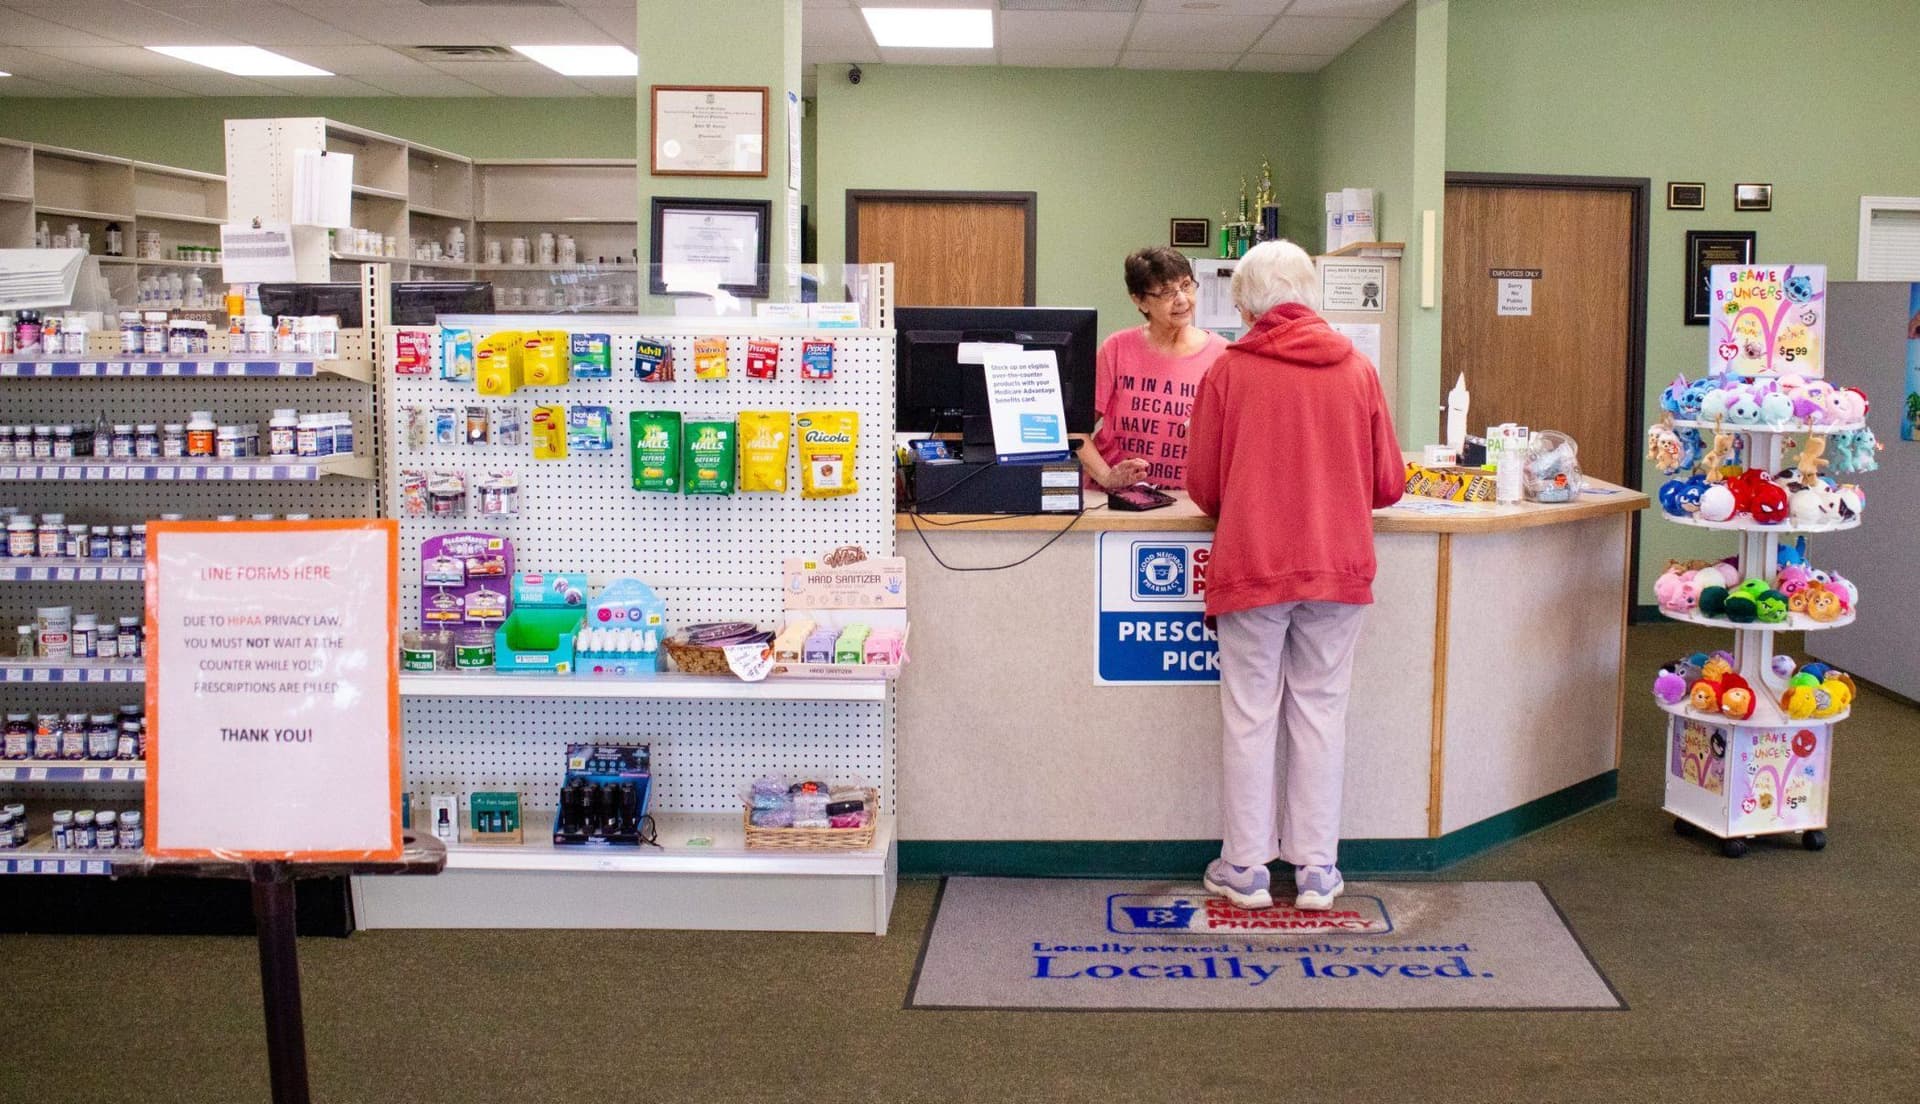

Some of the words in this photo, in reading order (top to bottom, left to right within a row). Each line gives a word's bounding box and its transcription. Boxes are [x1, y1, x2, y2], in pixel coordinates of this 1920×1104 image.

[1730, 269, 1777, 282] BEANIE
[1716, 286, 1782, 300] BOUNCERS
[638, 345, 661, 357] Advil
[1115, 376, 1134, 390] I'M
[1141, 378, 1156, 392] IN
[1163, 381, 1173, 395] A
[1180, 383, 1197, 398] HU
[1131, 397, 1192, 417] BECAUS
[1113, 416, 1117, 431] I
[1121, 417, 1159, 434] HAVE
[1167, 422, 1186, 438] TO
[805, 430, 850, 443] Ricola
[637, 439, 669, 449] HALLS
[691, 441, 725, 451] HALLS
[1161, 443, 1188, 459] BEF
[1145, 463, 1187, 480] ORGE
[1140, 554, 1155, 573] GOOD
[1156, 552, 1184, 574] NEIGHBOR
[201, 567, 232, 580] LINE
[237, 567, 290, 580] FORMS
[294, 566, 331, 580] HERE
[808, 576, 832, 584] HAND
[835, 575, 881, 584] SANITIZER
[1142, 579, 1181, 592] PHARMACY
[184, 616, 206, 627] DUE
[210, 616, 225, 627] TO
[227, 616, 262, 627] HIPAA
[265, 615, 310, 627] PRIVACY
[184, 638, 207, 648] YOU
[211, 638, 243, 648] MUST
[246, 638, 270, 648] NOT
[273, 638, 301, 648] WAIT
[304, 638, 320, 648] AT
[322, 638, 343, 648] THE
[199, 660, 251, 671] COUNTER
[255, 660, 289, 671] WHILE
[292, 660, 323, 671] YOUR
[279, 682, 300, 693] ARE
[220, 729, 269, 742] THANK
[274, 729, 313, 742] YOU!
[1752, 733, 1787, 745] BEANE
[1207, 910, 1360, 919] NEIGHBOR
[1207, 920, 1373, 929] PHARMACY
[1033, 943, 1136, 954] Locally
[1142, 944, 1239, 952] owned.
[1246, 944, 1346, 955] Locally
[1353, 943, 1478, 955] operated.
[1030, 956, 1284, 986] Locally
[1296, 956, 1494, 978] loved.
